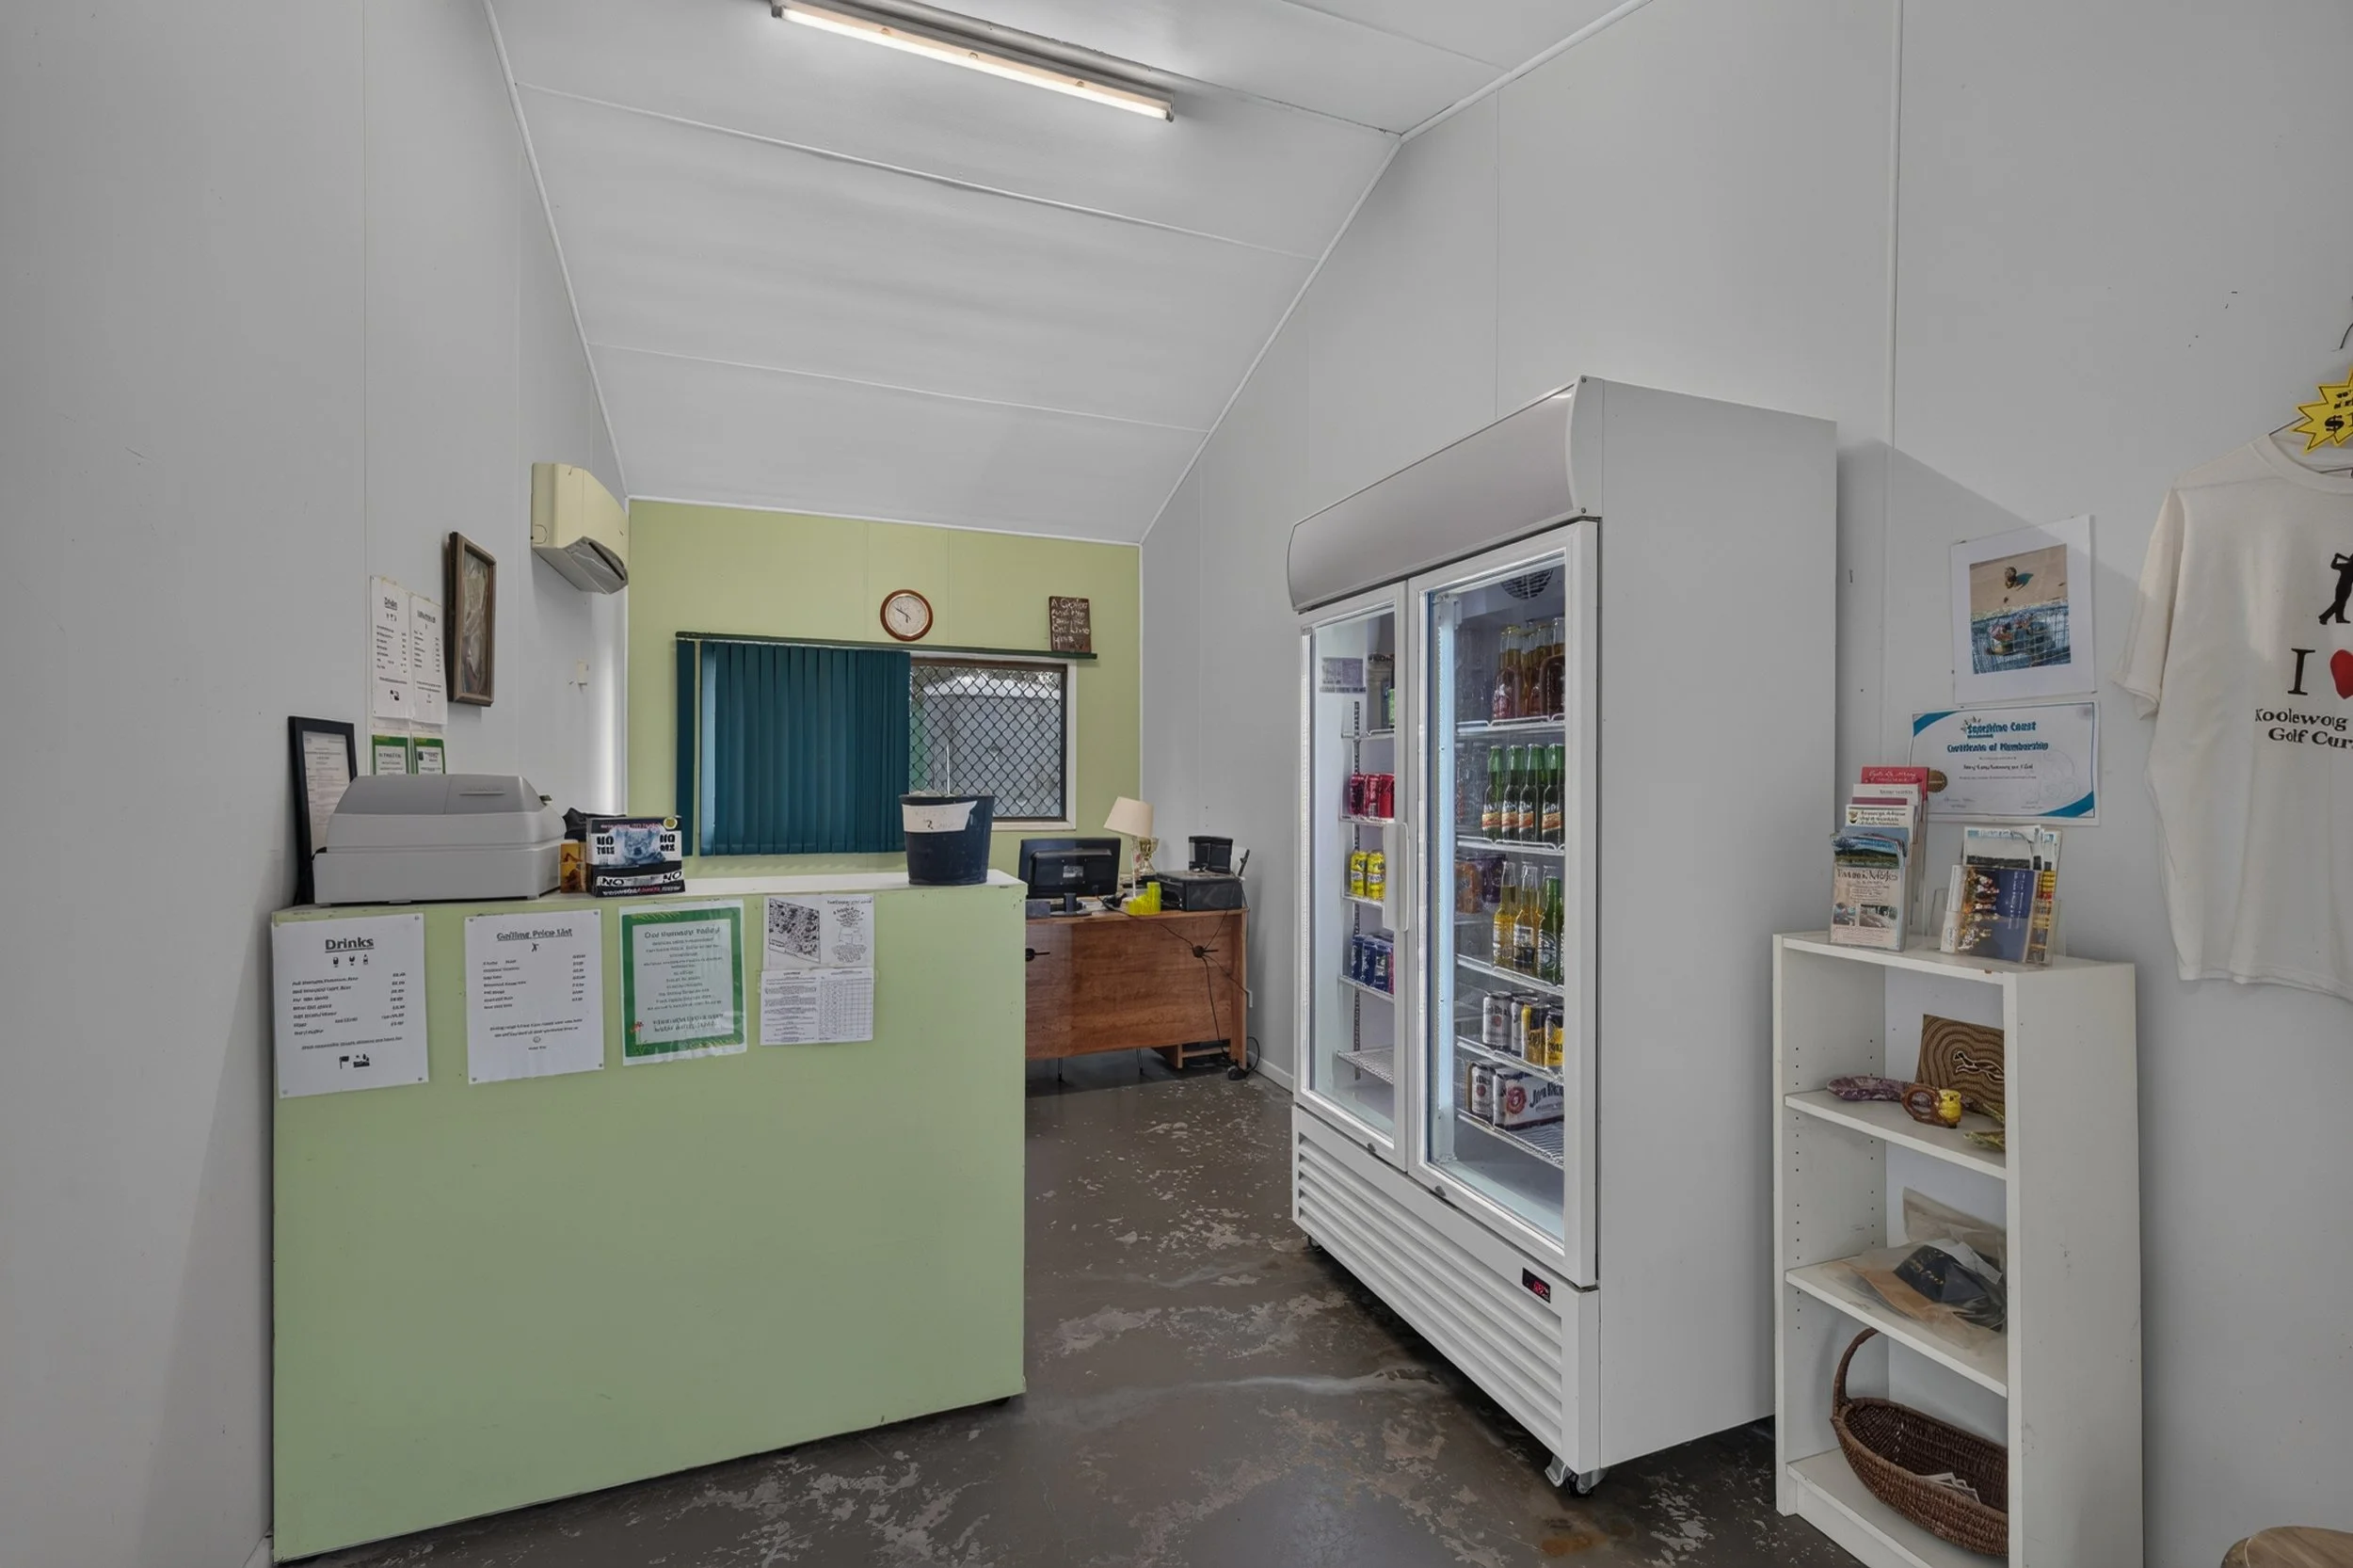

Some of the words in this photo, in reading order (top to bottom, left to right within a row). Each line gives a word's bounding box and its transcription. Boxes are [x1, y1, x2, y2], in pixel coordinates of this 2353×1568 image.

[2287, 648, 2315, 696] I
[2268, 727, 2309, 744] Golf
[1989, 743, 1997, 751] of
[325, 936, 375, 951] Drinks
